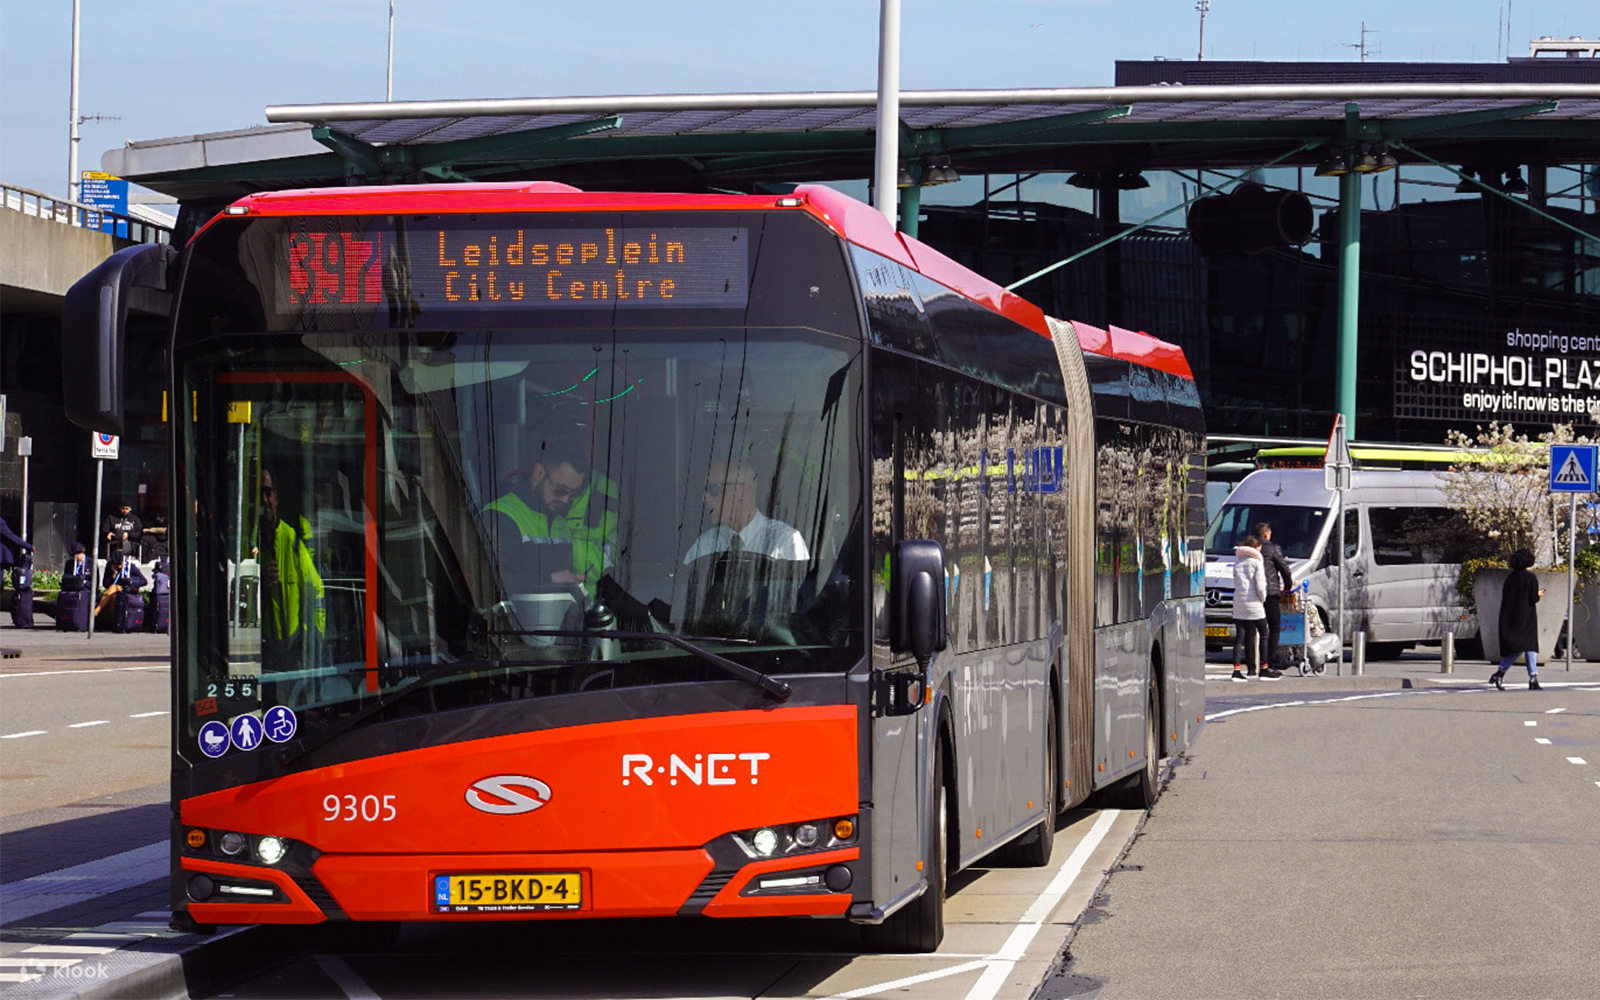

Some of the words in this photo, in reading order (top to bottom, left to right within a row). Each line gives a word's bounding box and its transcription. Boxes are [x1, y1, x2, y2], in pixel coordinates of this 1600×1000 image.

[438, 228, 685, 266] Leidseplein
[445, 270, 525, 301] City
[547, 268, 676, 300] Centre
[1506, 328, 1569, 353] shopping
[1410, 350, 1542, 388] SCHIPHOL
[1462, 390, 1501, 413] enjoy
[1548, 393, 1560, 412] is
[1561, 394, 1585, 413] the
[322, 794, 397, 822] 9305
[438, 893, 449, 901] NL
[457, 879, 569, 901] 15-BKD-4
